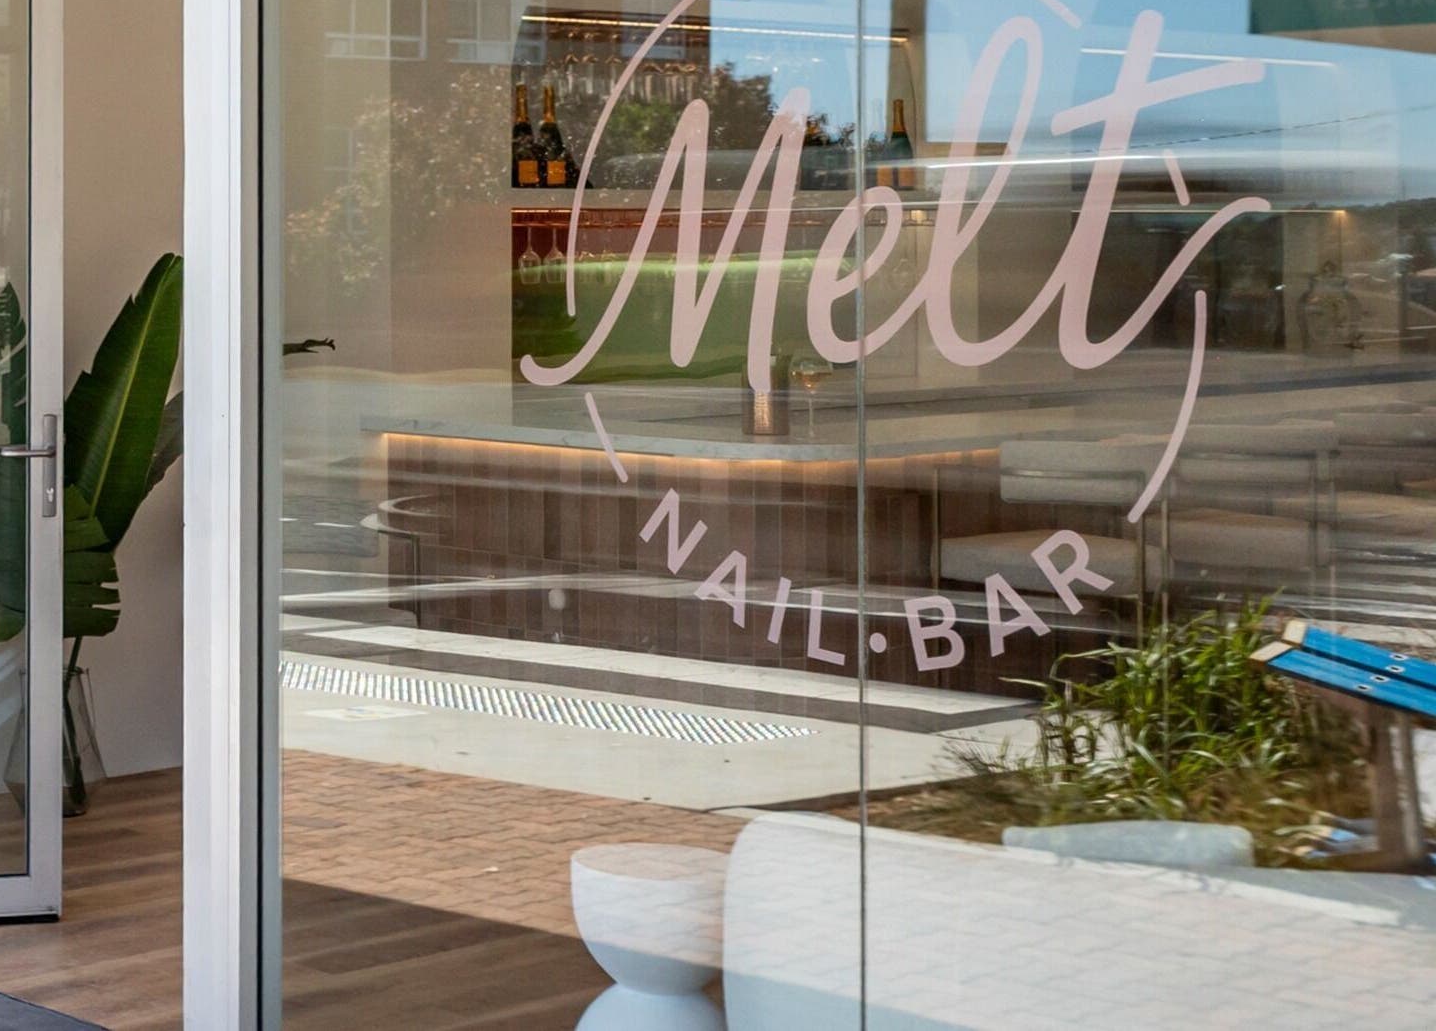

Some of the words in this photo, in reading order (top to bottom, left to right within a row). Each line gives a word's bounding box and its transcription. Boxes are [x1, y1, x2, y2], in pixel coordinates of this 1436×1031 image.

[519, 9, 1272, 393] Melt
[638, 487, 846, 666] NAIL
[903, 528, 1115, 673] BAR
